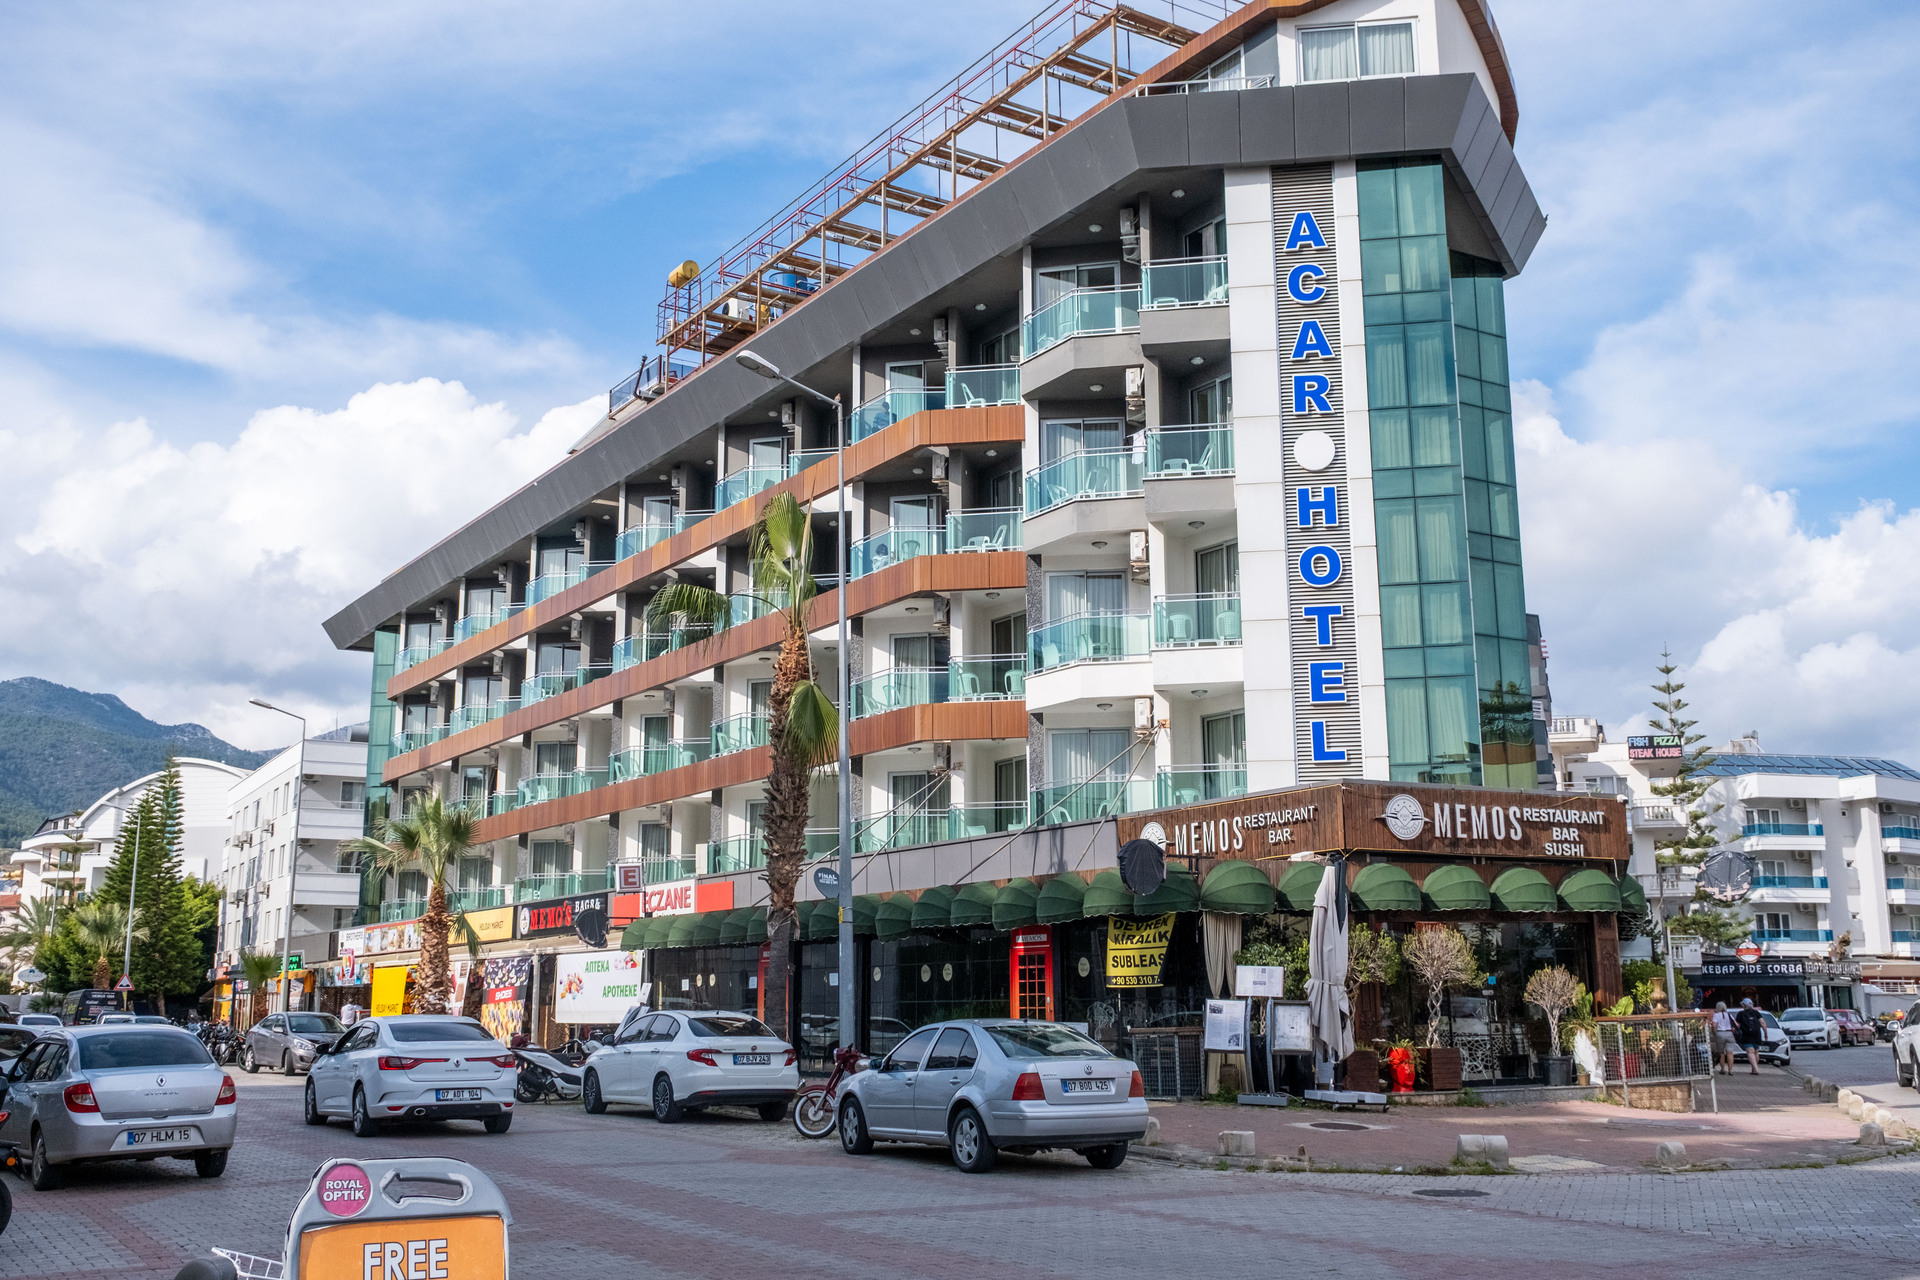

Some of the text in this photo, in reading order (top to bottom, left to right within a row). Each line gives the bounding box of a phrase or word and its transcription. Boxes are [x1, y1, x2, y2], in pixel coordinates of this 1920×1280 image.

[1284, 211, 1336, 415] ACAR
[1296, 486, 1348, 762] HOTEL
[1628, 736, 1680, 747] FISH PIZZA
[1630, 747, 1681, 758] STEAK HOUSE
[1434, 802, 1523, 841] MEMOS
[1523, 807, 1604, 825] RESTAURANT
[1174, 805, 1315, 855] MEMOS RESTAURANT
[1269, 828, 1291, 843] BAR
[1552, 827, 1580, 842] BAR
[1545, 843, 1584, 857] SUSHI
[624, 869, 637, 886] E
[642, 886, 691, 913] ECZANE
[530, 901, 572, 930] MEMO'S
[1114, 930, 1170, 945] KİRALIK
[585, 959, 610, 973] АПТЕКА
[1702, 963, 1803, 976] KEBAP PİDE ÇORBA
[1112, 976, 1125, 985] +90
[1126, 976, 1137, 984] 530
[495, 989, 513, 1001] SHOES
[602, 984, 638, 998] APOTHEKE
[1068, 1082, 1076, 1091] 07
[1095, 1080, 1109, 1090] 425
[441, 1091, 449, 1099] 07
[134, 1129, 190, 1143] 07 HLM 15
[326, 1179, 363, 1190] ROYAL
[323, 1189, 365, 1202] OPTİK
[363, 1238, 448, 1280] FREE
